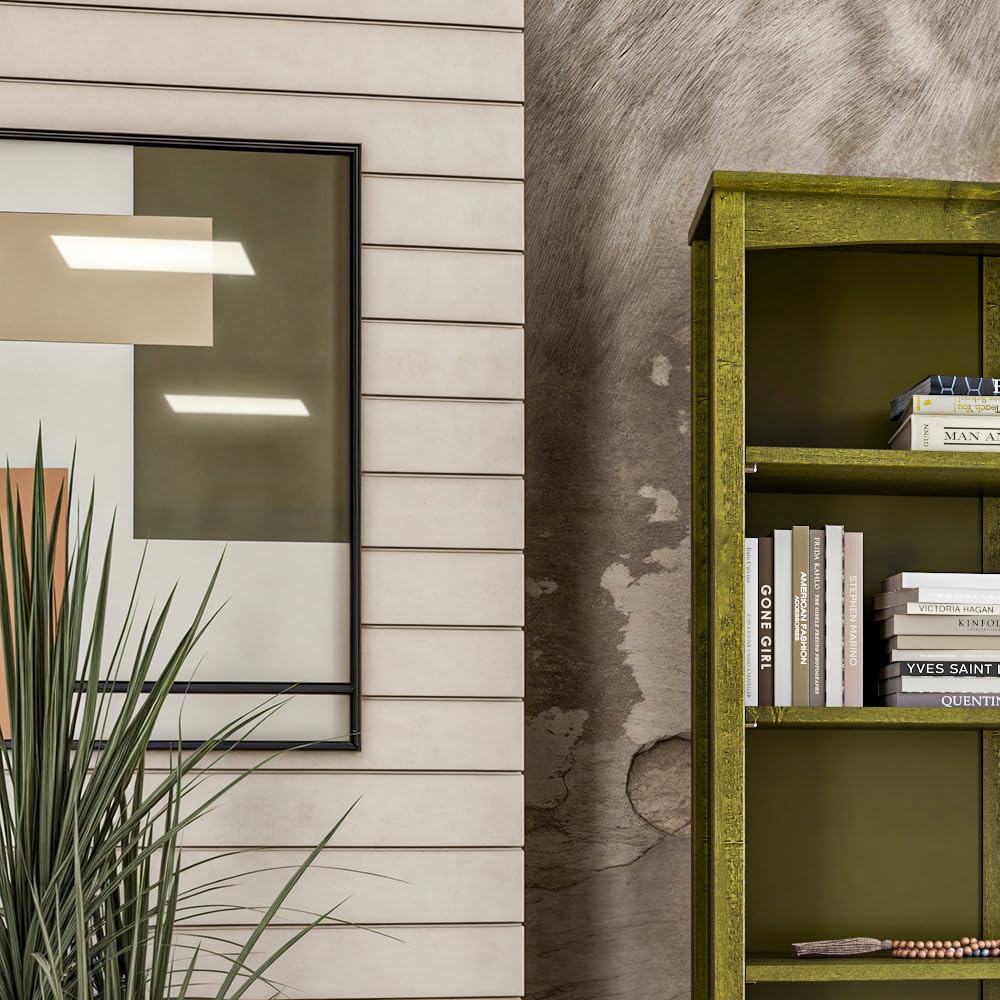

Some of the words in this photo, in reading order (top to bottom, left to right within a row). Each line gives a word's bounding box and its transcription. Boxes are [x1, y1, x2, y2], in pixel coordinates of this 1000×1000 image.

[957, 405, 972, 413] You
[975, 405, 1000, 414] Teach
[943, 431, 980, 441] MAN
[760, 584, 772, 629] GONE
[800, 571, 808, 621] AMERICAN
[849, 575, 858, 622] STEPHEN
[918, 605, 961, 613] VICTORIA
[963, 605, 994, 613] HAGAN
[760, 636, 772, 670] GIRL
[800, 624, 808, 665] FASHION
[849, 625, 858, 666] MARINO
[907, 663, 944, 674] YVES
[950, 664, 993, 675] SAINT
